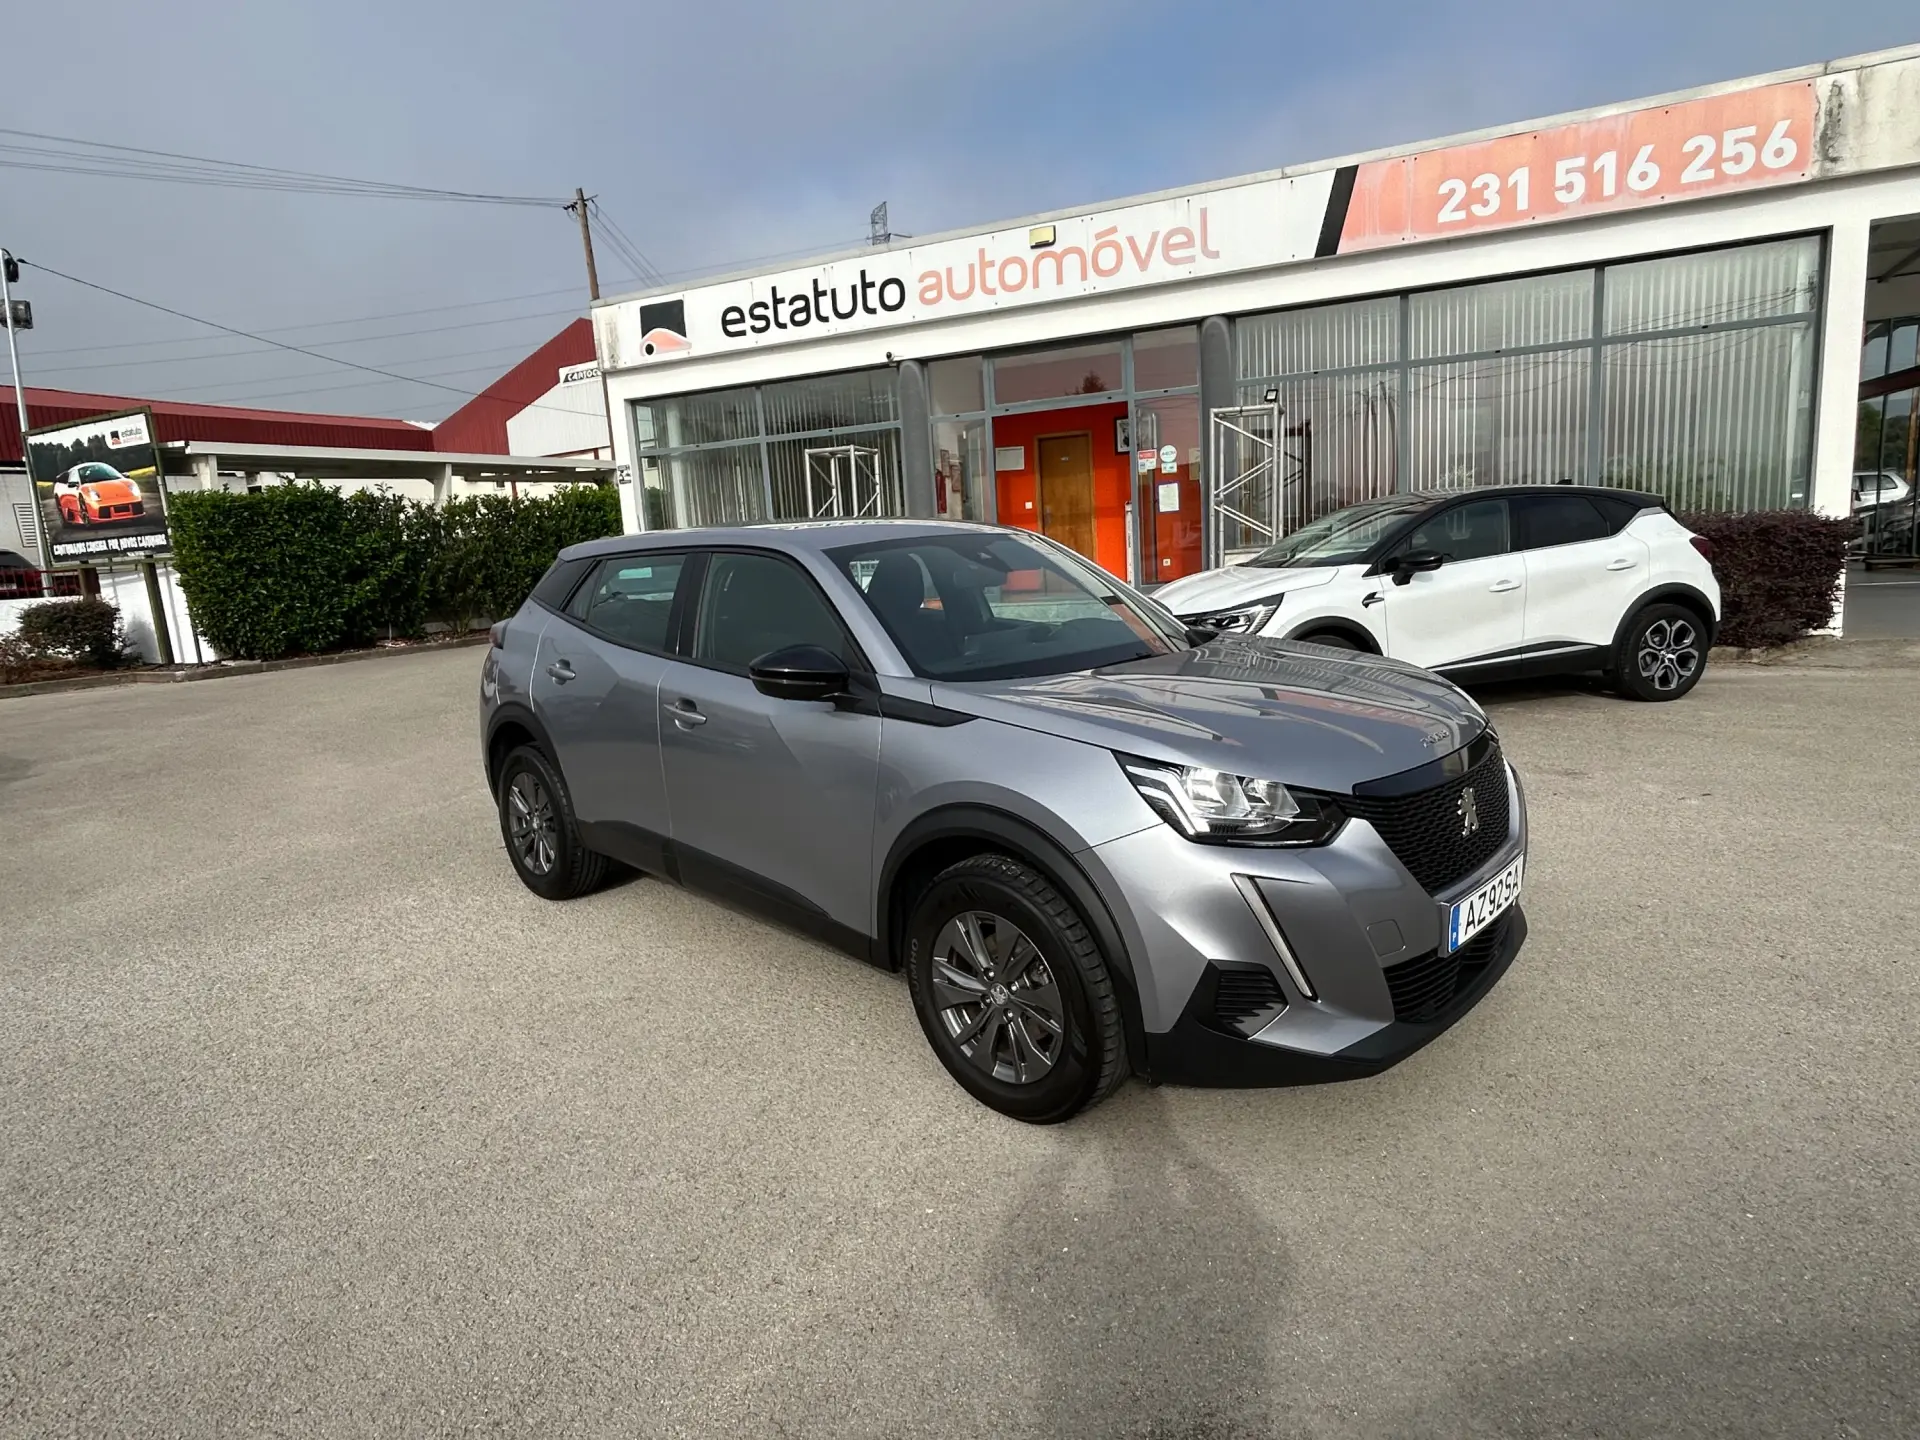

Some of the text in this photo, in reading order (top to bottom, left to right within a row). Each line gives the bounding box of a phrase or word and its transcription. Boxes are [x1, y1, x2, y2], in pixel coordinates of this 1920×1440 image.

[1437, 119, 1798, 223] 231 516 256
[721, 207, 1221, 338] estatuto automóvel
[1464, 864, 1519, 936] AZ92SA
